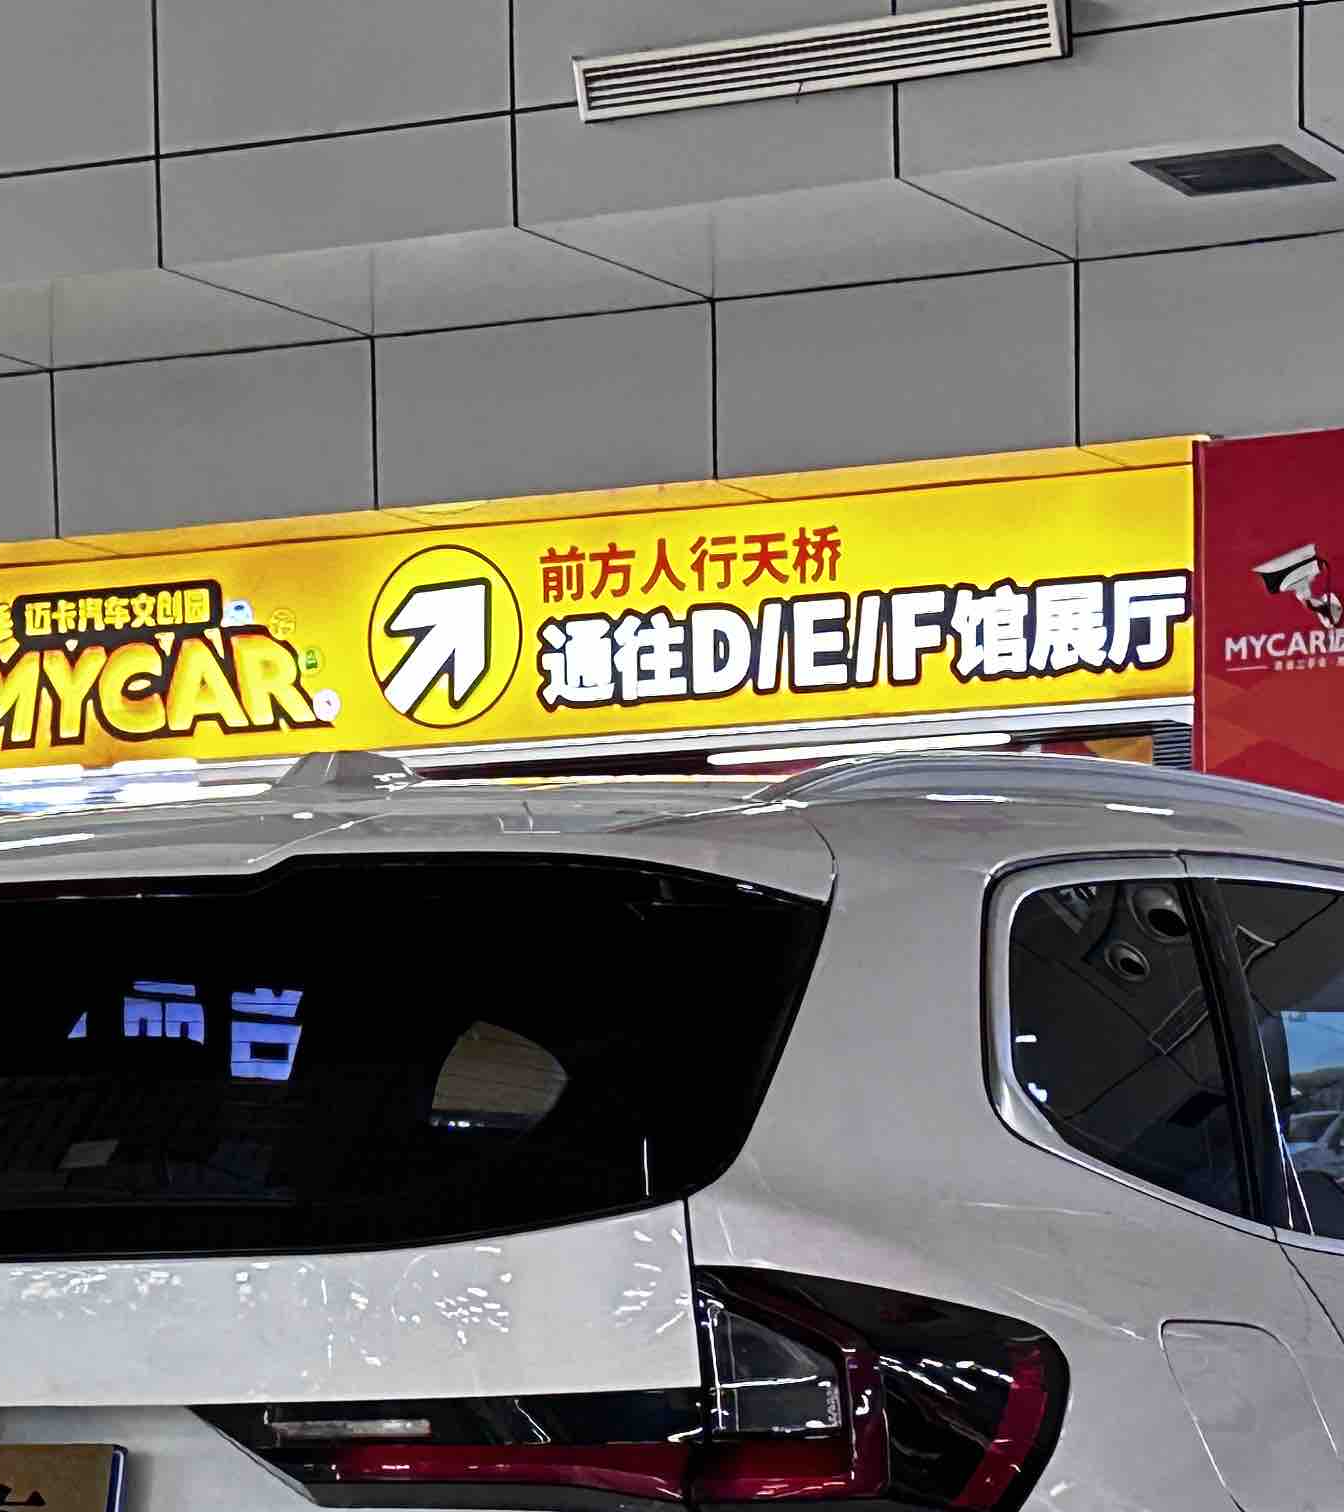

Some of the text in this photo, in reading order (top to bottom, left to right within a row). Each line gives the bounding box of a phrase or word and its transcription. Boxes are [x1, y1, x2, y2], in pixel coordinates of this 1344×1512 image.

[541, 525, 842, 603] 前方人行天桥
[24, 587, 211, 637] 迈卡汽车文创园
[542, 576, 1190, 706] 通往D/E/F馆展厅
